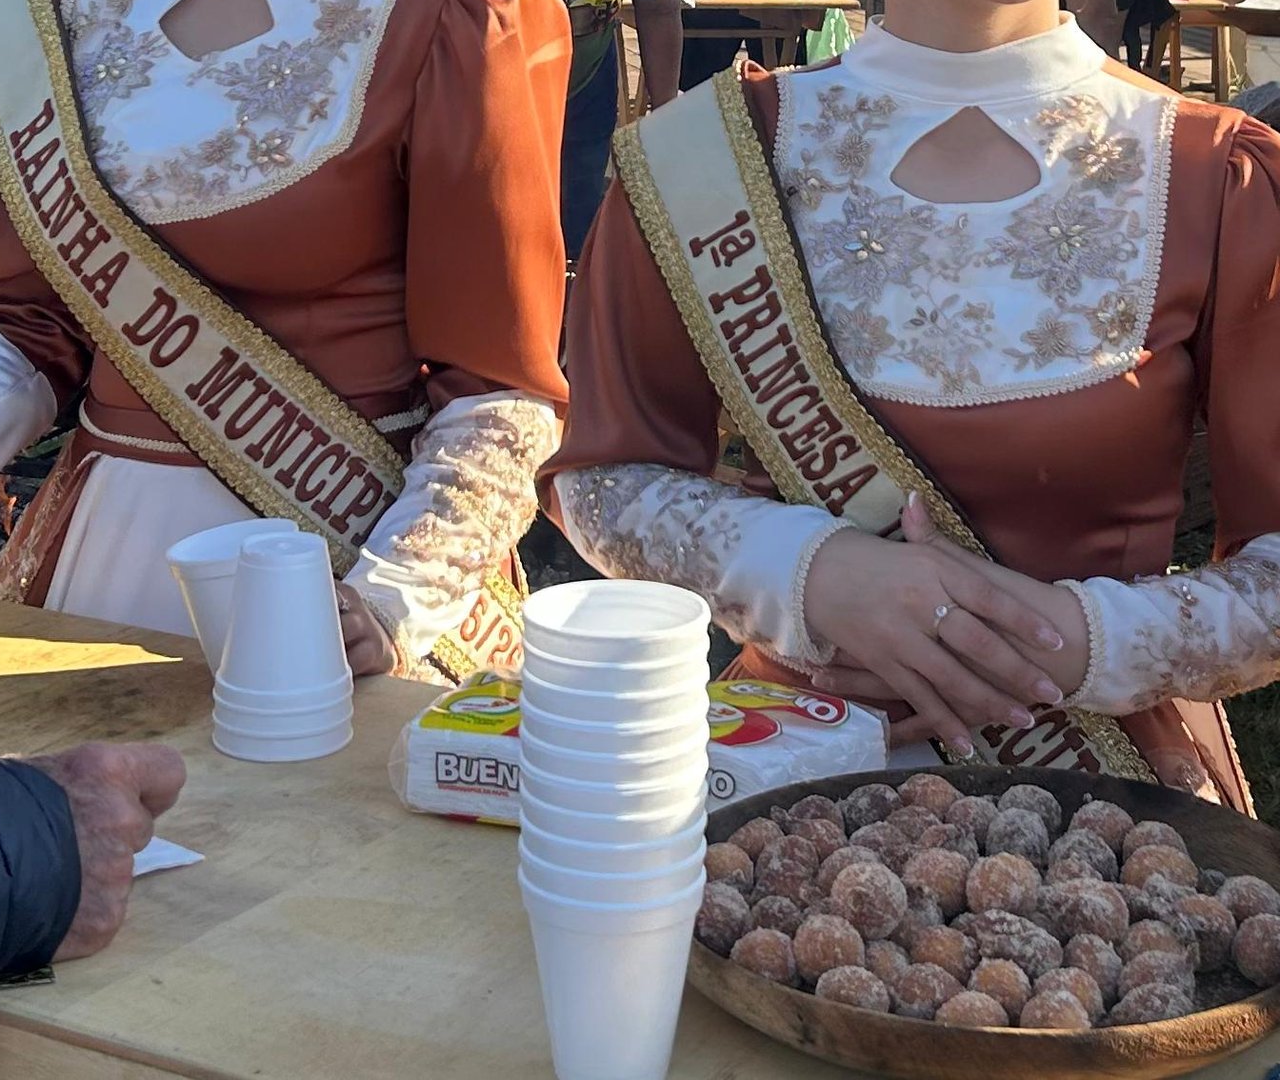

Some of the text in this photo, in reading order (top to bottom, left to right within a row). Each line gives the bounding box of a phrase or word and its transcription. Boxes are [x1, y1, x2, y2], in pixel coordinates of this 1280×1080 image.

[10, 98, 128, 309] RAINHA
[121, 287, 199, 369] DO
[709, 264, 881, 516] PRINCESA
